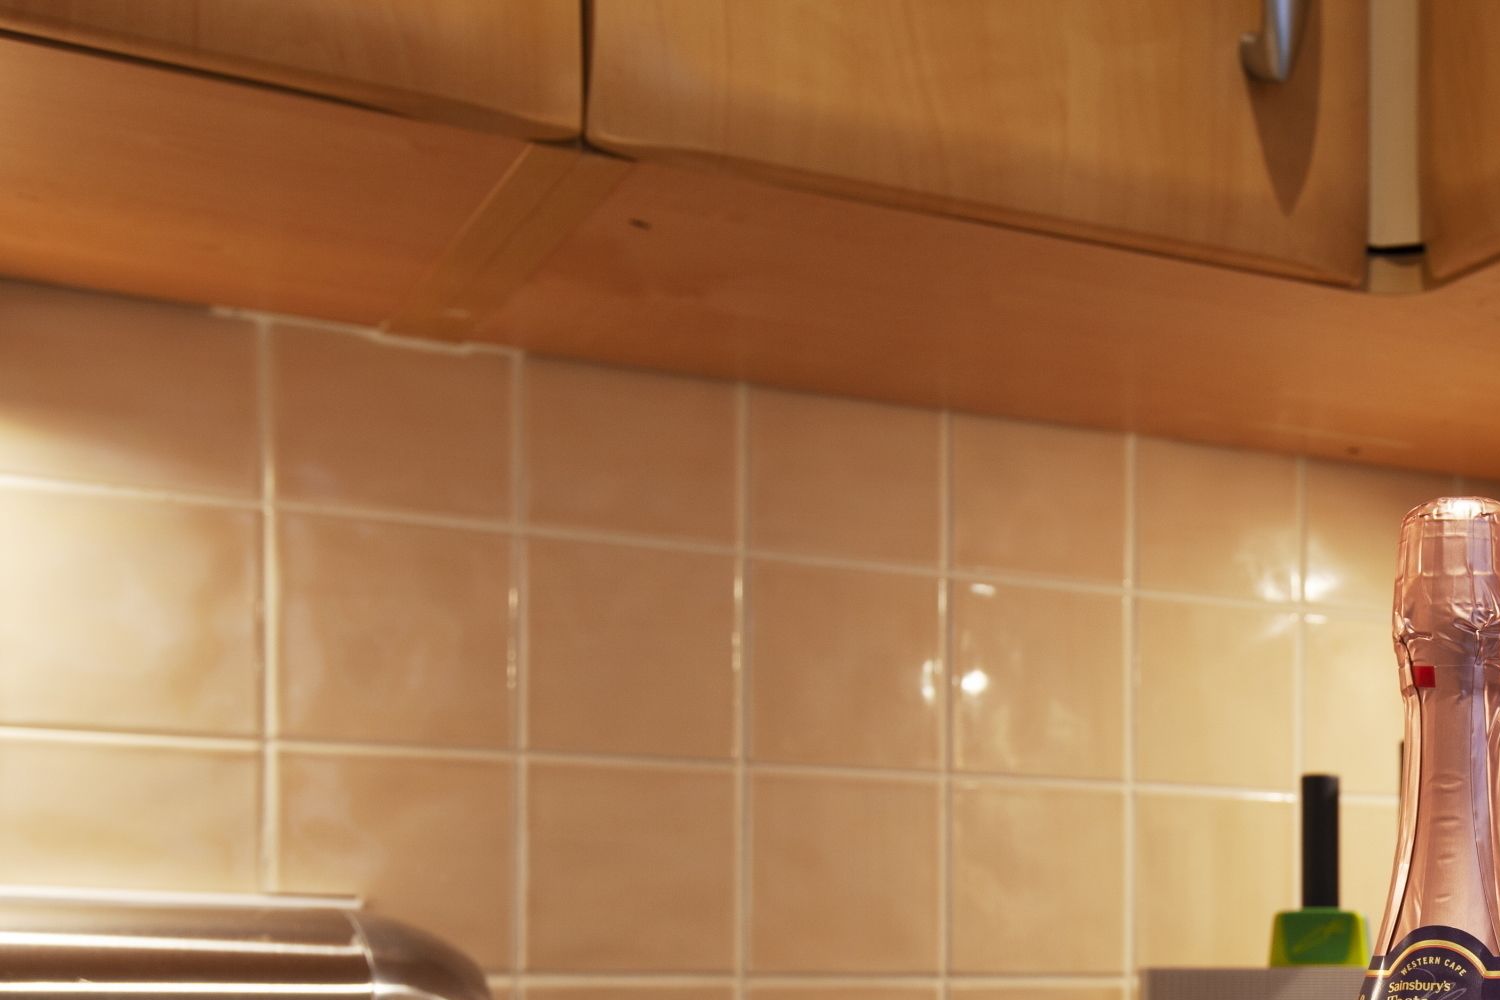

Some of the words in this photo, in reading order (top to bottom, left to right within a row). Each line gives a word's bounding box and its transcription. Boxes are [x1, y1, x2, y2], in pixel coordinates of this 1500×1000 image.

[1401, 956, 1440, 976] WESTERN
[1444, 958, 1467, 976] CAPE
[1388, 980, 1451, 993] Sainsbury's
